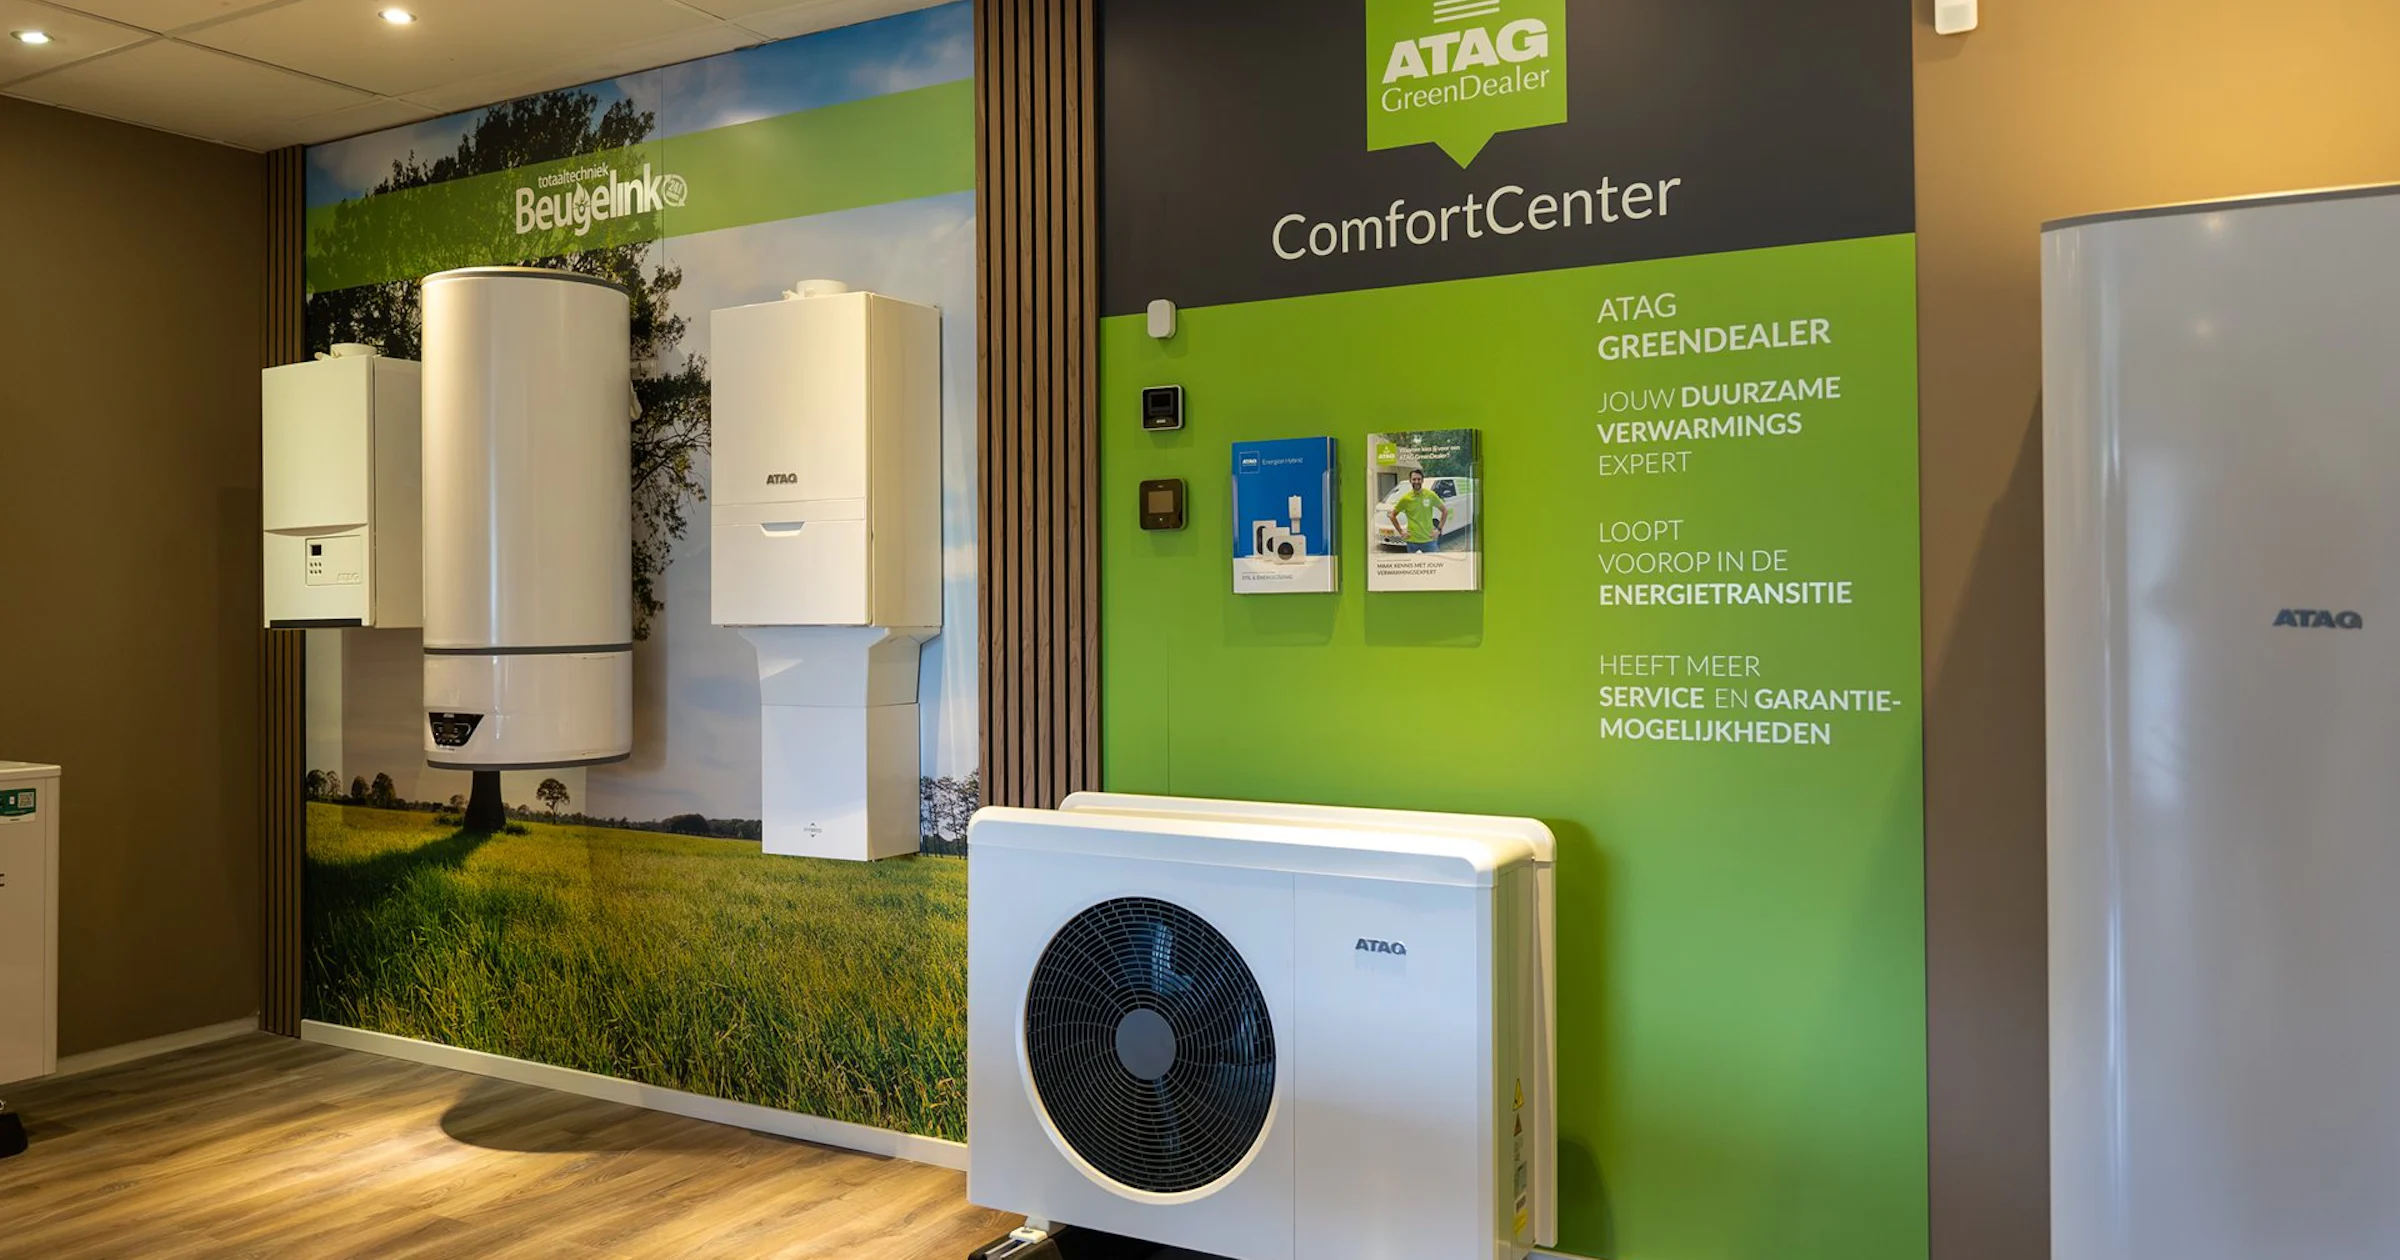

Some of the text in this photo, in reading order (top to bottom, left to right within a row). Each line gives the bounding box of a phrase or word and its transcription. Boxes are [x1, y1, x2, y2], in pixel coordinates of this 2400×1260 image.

[1381, 18, 1549, 84] ATAG
[1381, 66, 1550, 113] GreenDealer
[538, 161, 610, 189] totaaltechniek
[515, 163, 664, 237] Beugelink
[1271, 175, 1682, 261] ComfortCenter
[1597, 292, 1677, 324] ATAG
[1598, 318, 1831, 361] GREENDEALER
[1597, 376, 1841, 414] JOUW DUURZAME
[1597, 412, 1802, 445] VERWARMINGS
[1599, 451, 1692, 476] EXPERT
[766, 474, 798, 485] ATAG
[1599, 520, 1684, 543] LOOPT
[1598, 550, 1788, 574] VOOROP IN DE
[1600, 581, 1853, 606] ENERGIETRANSITIE
[2272, 608, 2363, 630] ATAG
[1599, 655, 1761, 677] HEEFT MEER
[1600, 686, 1902, 712] SERVICE EN GARANTIE-
[1600, 718, 1831, 745] MOGELIJKHEDEN
[1355, 938, 1407, 956] ATAG
